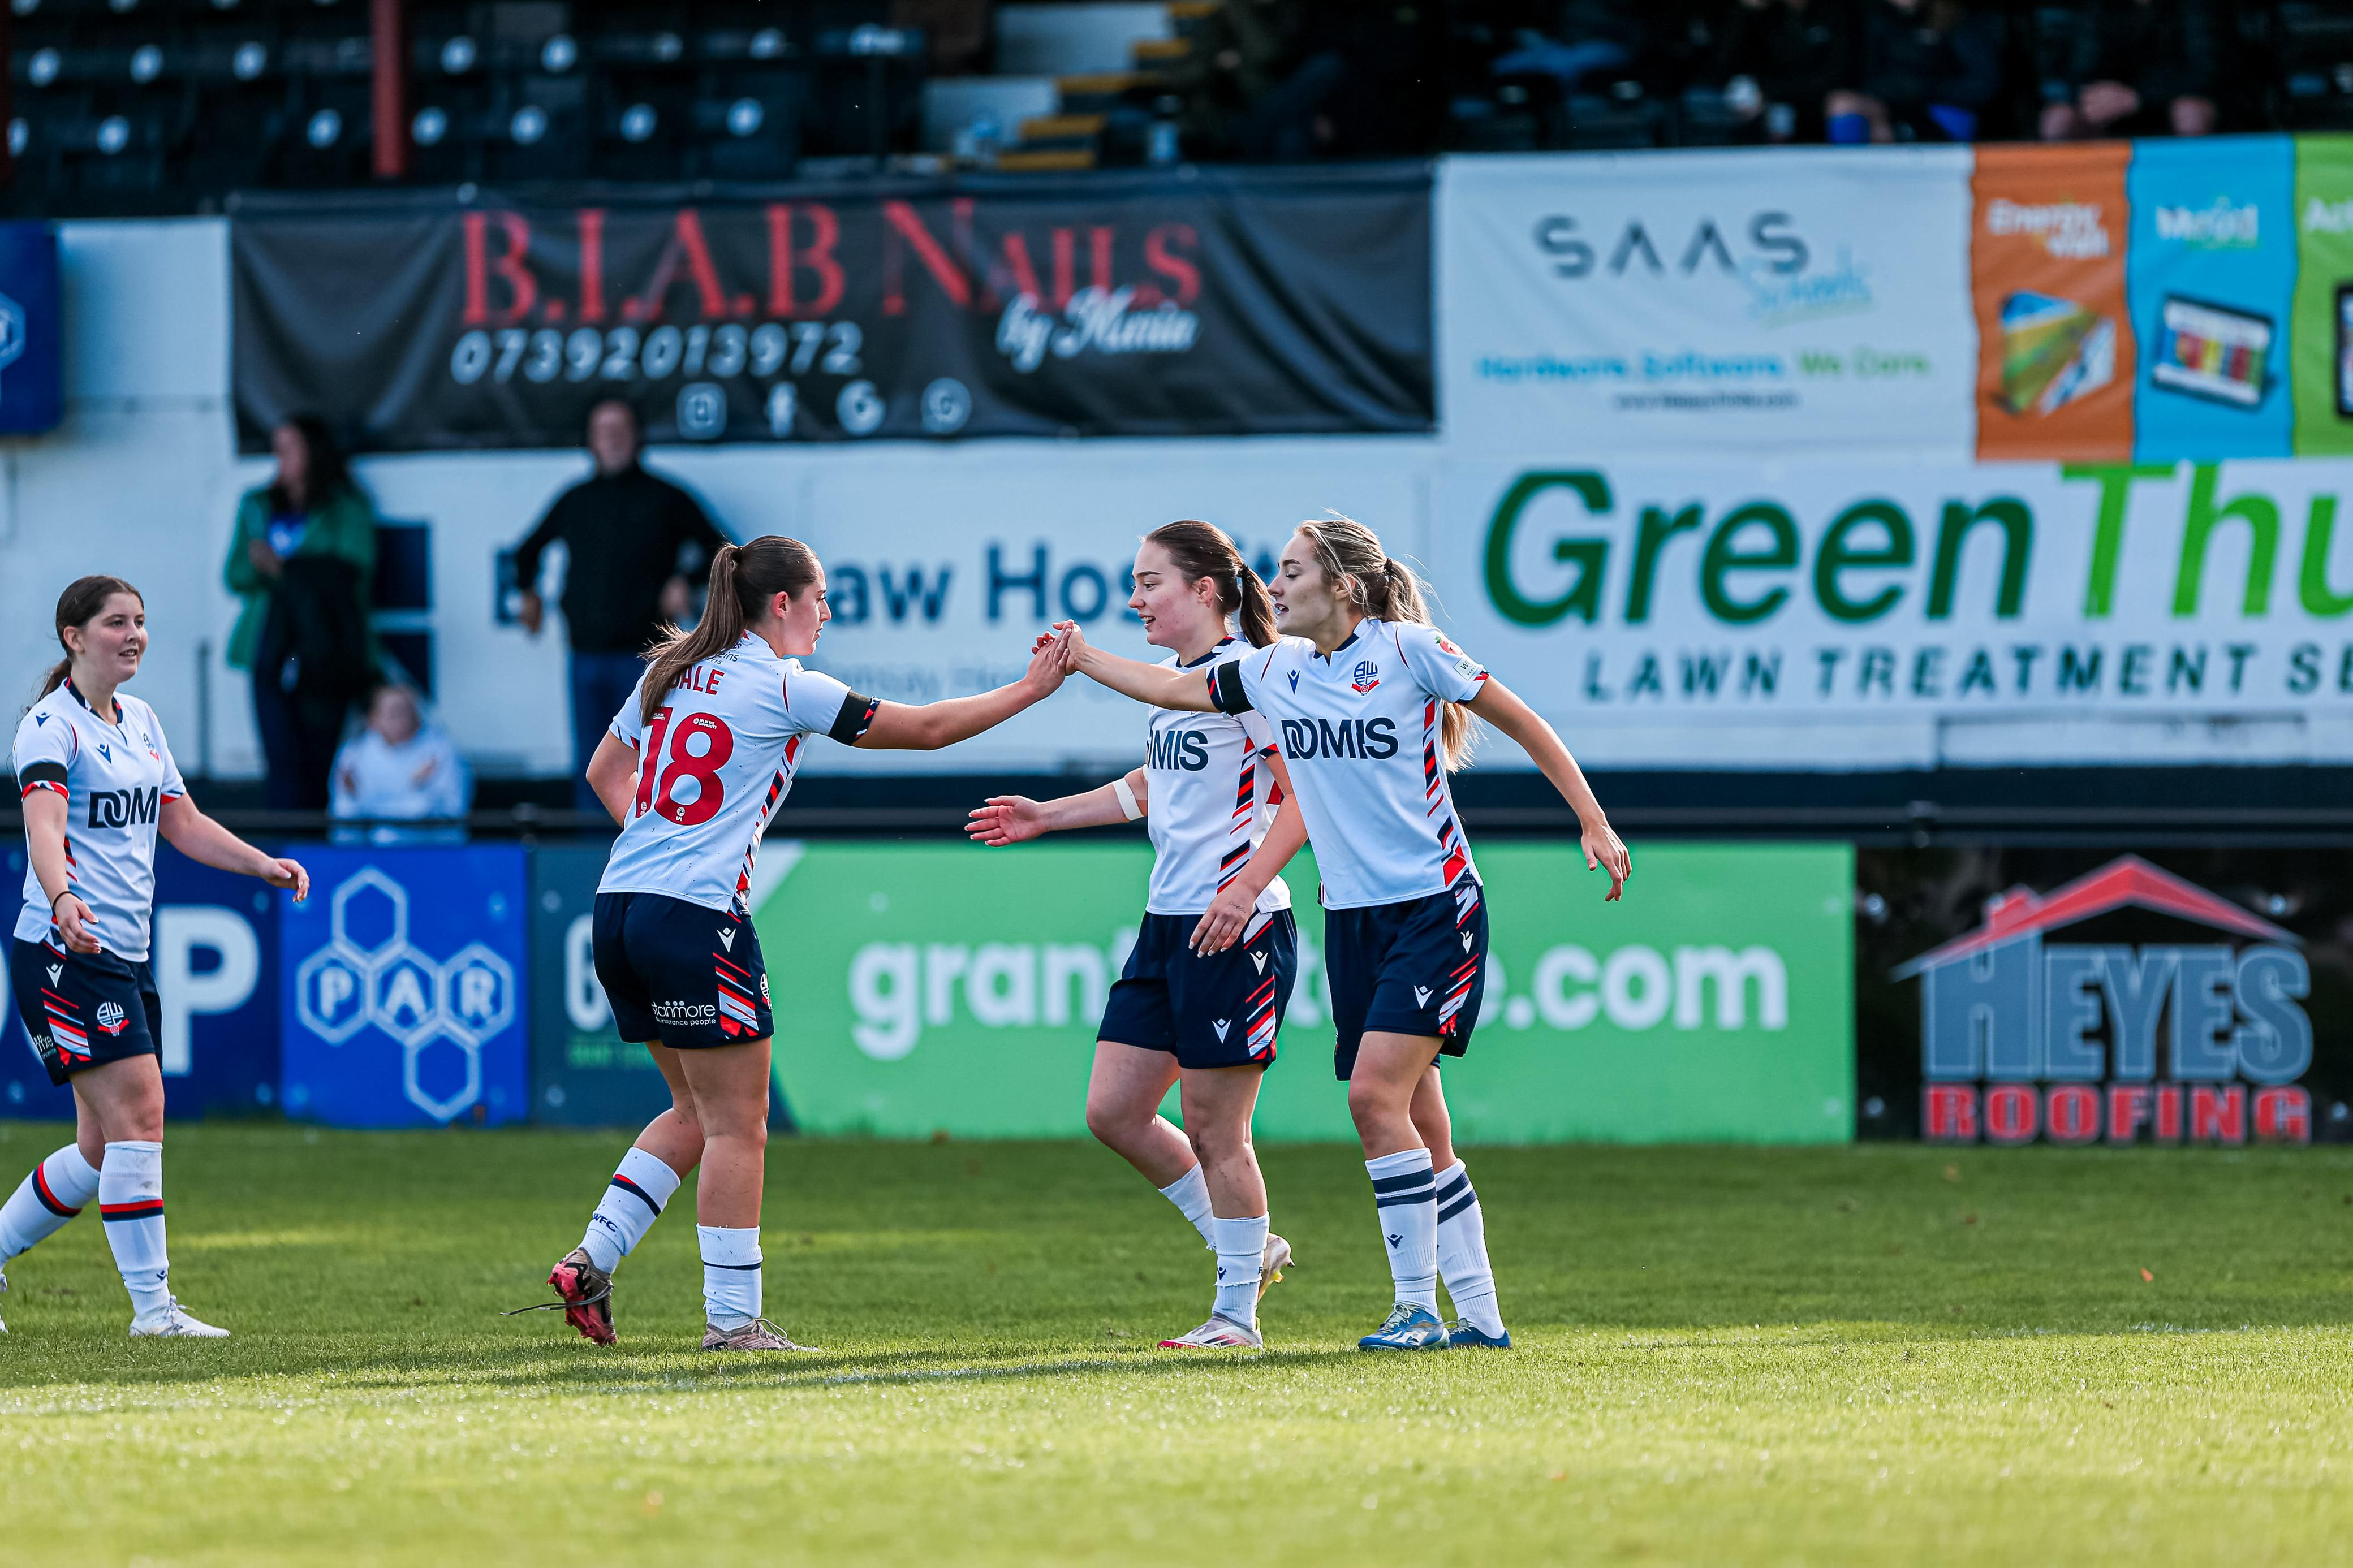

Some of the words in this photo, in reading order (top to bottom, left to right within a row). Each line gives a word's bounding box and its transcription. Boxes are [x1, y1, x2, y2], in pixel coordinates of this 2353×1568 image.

[1533, 210, 1810, 279] SAAS
[451, 321, 864, 386] 07392013972
[1583, 649, 1783, 703] LAWN
[1815, 645, 2257, 701] TREATMENT
[635, 706, 734, 826] 18
[1146, 729, 1209, 771] MIS
[1281, 716, 1399, 760] DOMIS
[319, 960, 496, 1019] PAR
[1921, 932, 2313, 1083] HEYES
[690, 1017, 716, 1026] people
[1923, 1083, 2312, 1144] ROOFING
[594, 1213, 618, 1232] WFC
